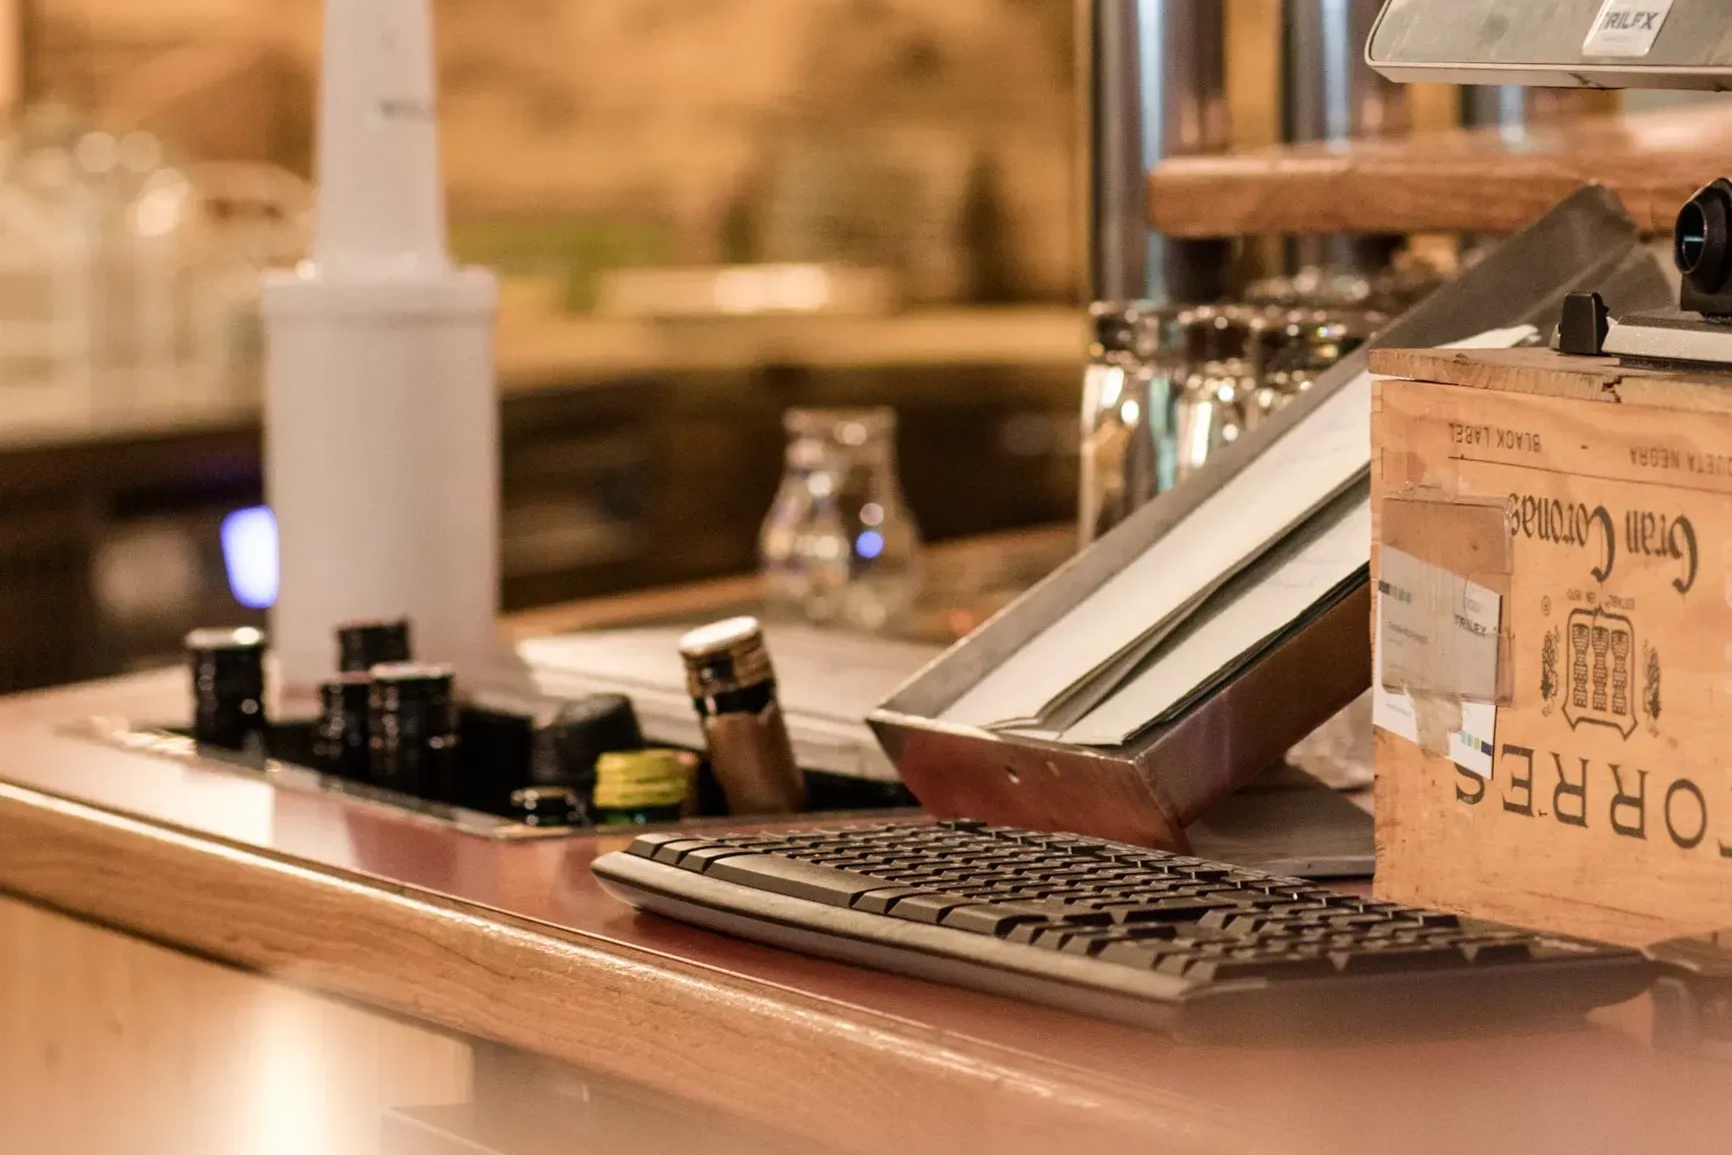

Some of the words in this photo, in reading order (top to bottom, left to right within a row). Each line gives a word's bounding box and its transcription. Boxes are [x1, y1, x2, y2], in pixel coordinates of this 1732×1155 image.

[1448, 423, 1490, 447] LABEL
[1496, 429, 1541, 453] BLACK
[1628, 446, 1681, 470] NEGRA
[1508, 494, 1616, 583] Coronas
[1625, 510, 1698, 597] Gran
